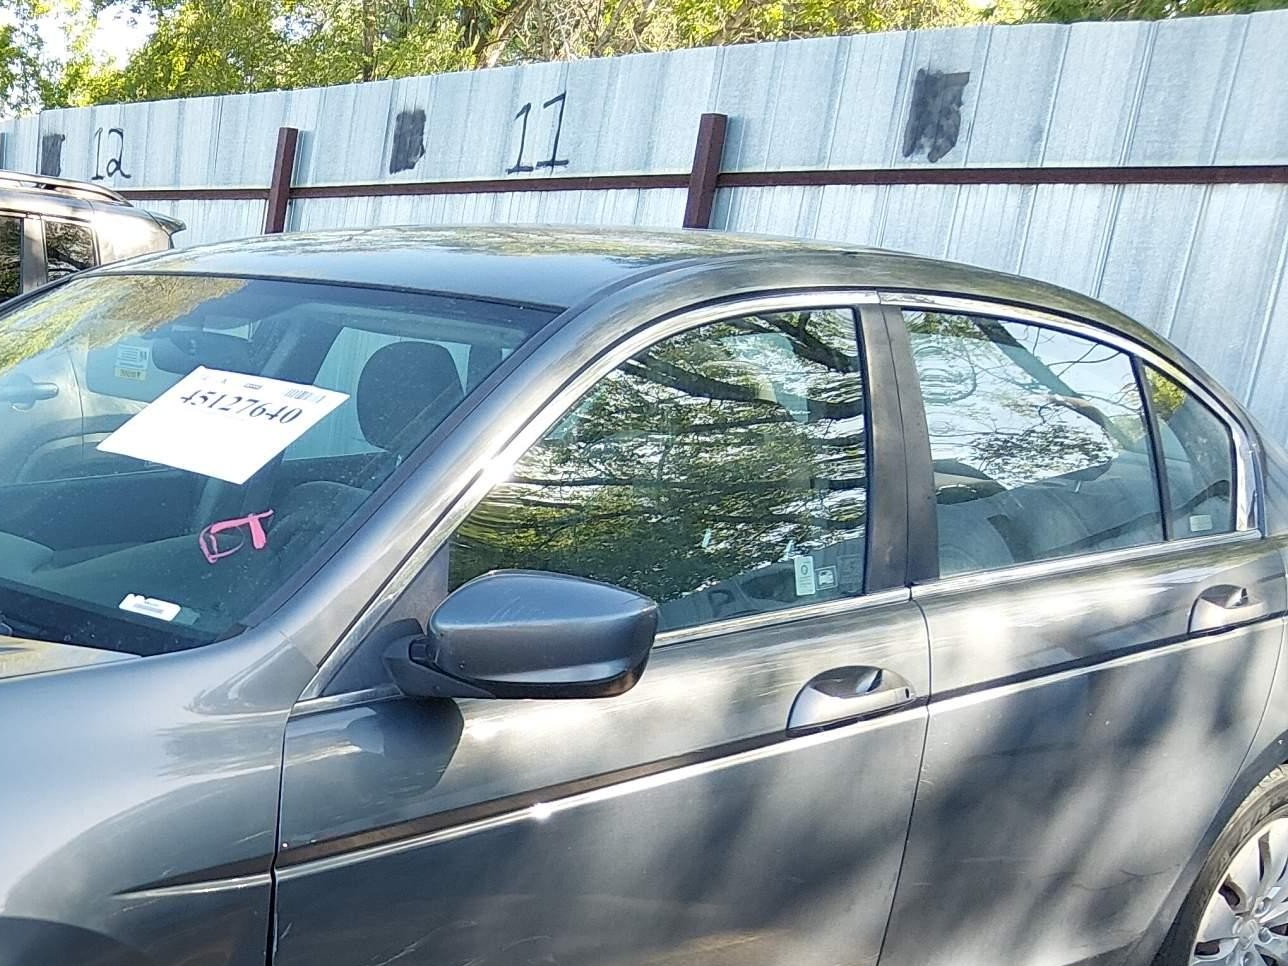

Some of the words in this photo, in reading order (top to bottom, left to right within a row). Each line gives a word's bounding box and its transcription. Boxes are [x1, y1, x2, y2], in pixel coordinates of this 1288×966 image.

[92, 127, 132, 180] 12
[505, 90, 569, 175] 11
[180, 389, 303, 424] 45127640
